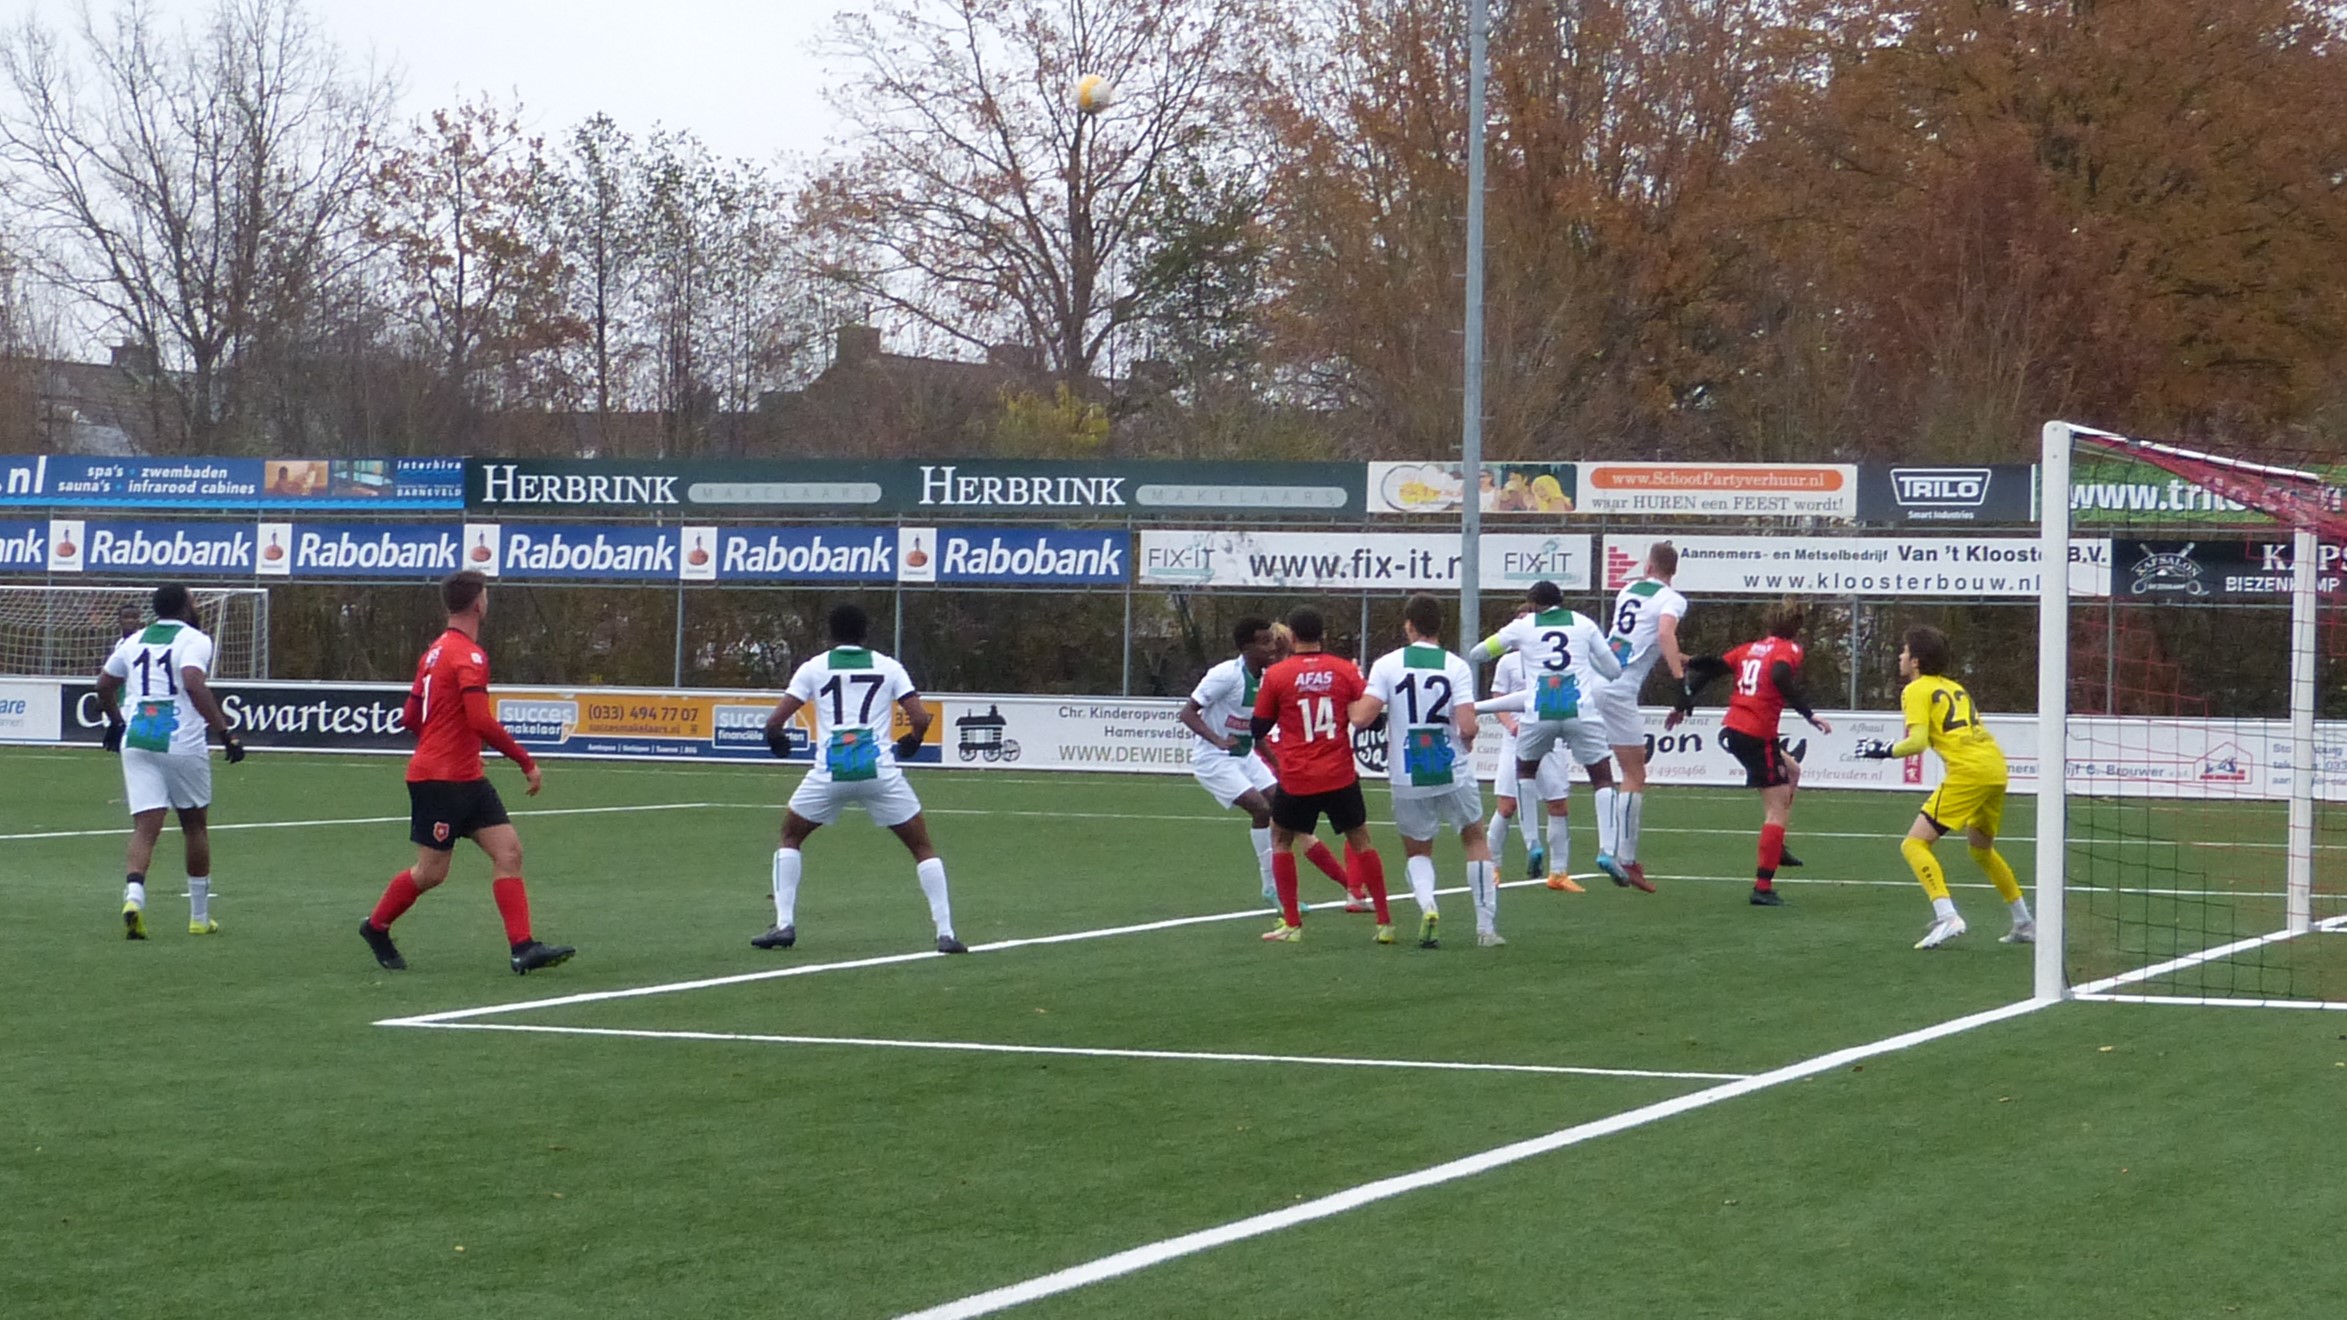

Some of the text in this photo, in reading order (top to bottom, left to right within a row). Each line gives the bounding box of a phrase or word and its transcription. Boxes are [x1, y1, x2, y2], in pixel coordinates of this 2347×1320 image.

[87, 465, 228, 479] spa's zwembaden
[482, 464, 679, 505] HERBRINK
[919, 465, 1126, 506] HERBRINK
[58, 480, 256, 494] sauna's infrarood cabines
[1898, 476, 1983, 498] TRILO
[1633, 495, 1697, 510] HUREN
[1701, 500, 1728, 510] een
[1733, 497, 1791, 512] FEEST
[1794, 498, 1844, 512] wordt!
[90, 530, 251, 567] Rabobank
[297, 532, 457, 568] Rabobank
[506, 533, 676, 571] Rabobank
[722, 536, 893, 573] Rabobank
[943, 537, 1122, 576] Rabobank
[1773, 550, 1790, 560] en
[1795, 549, 1888, 563] Metselbedrijf
[1898, 545, 1938, 562] Van
[1967, 546, 2042, 562] Kloost
[1249, 547, 1462, 579] www.fix-it.n
[1744, 572, 2041, 592] www.kloosterbouw.nl
[2225, 576, 2341, 592] BIEZENMP
[1618, 599, 1641, 635] 6
[1541, 630, 1571, 672] 3
[133, 647, 178, 697] 11
[1294, 670, 1334, 687] AFAS
[820, 674, 885, 725] 17
[1395, 672, 1452, 725] 12
[221, 694, 406, 734] Swarteste
[503, 708, 574, 723] succes
[588, 704, 698, 722] (033) 494 77 07
[719, 712, 762, 728] succ
[1058, 706, 1184, 723] Chr. Kinderopvang
[1297, 696, 1337, 743] 14
[1104, 725, 1196, 740] Hamersvelds
[1058, 744, 1194, 764] WWW.DEWIEBE
[2106, 764, 2164, 777] Brouwer
